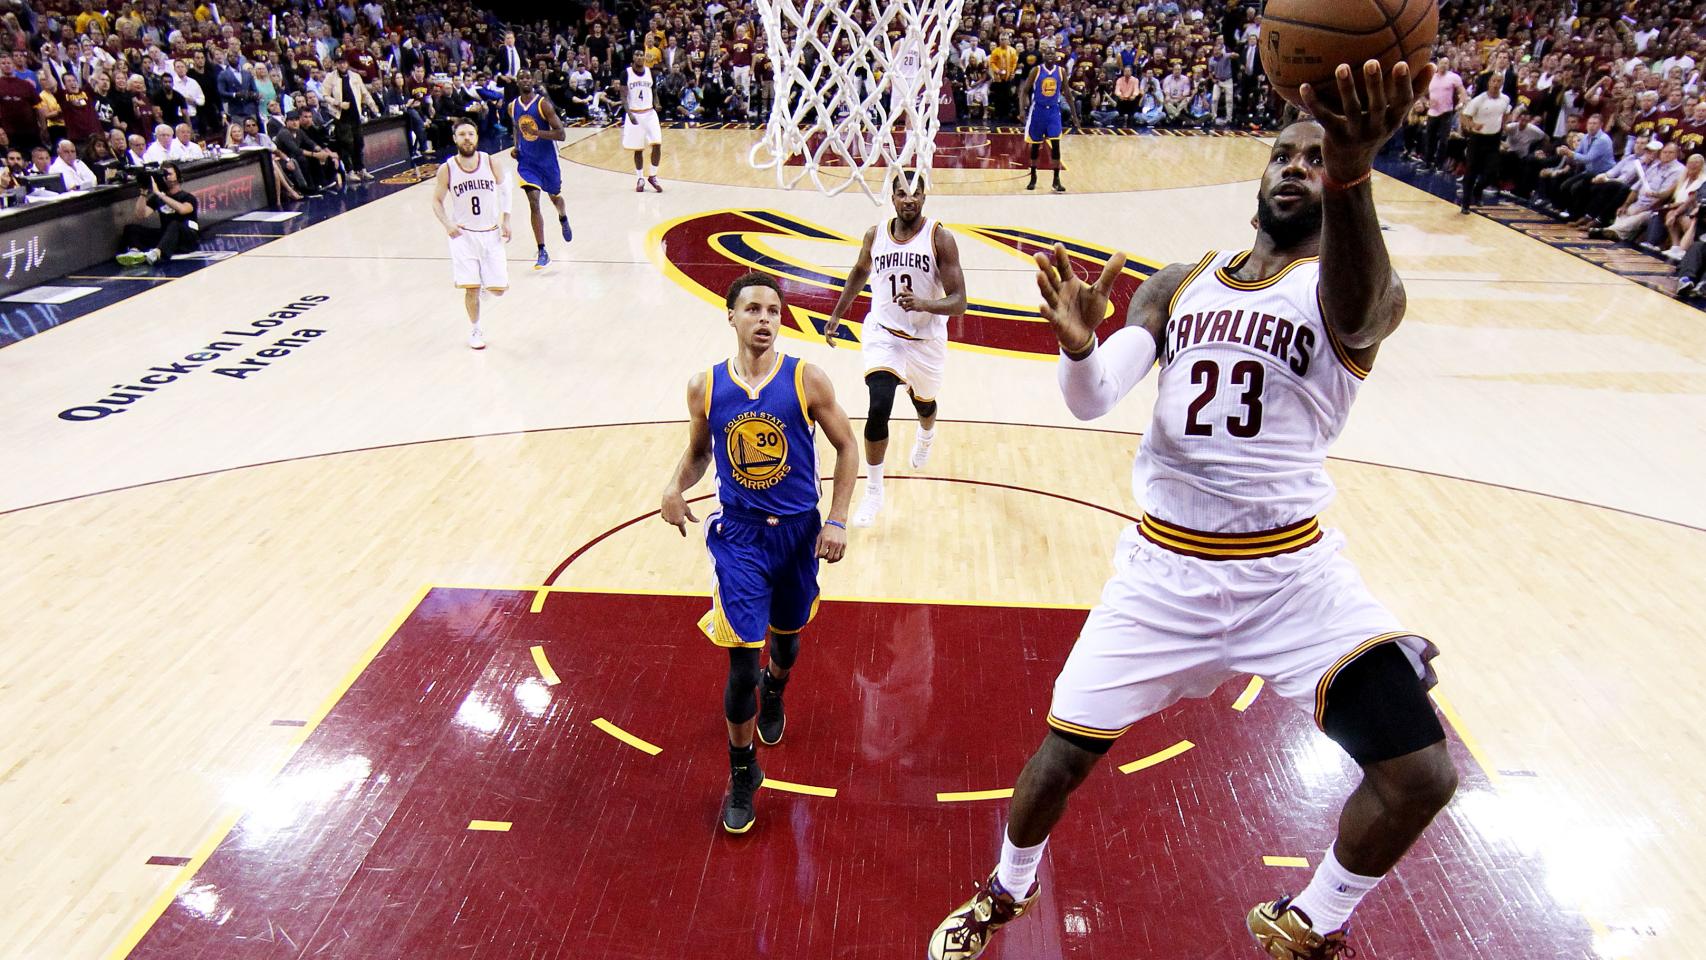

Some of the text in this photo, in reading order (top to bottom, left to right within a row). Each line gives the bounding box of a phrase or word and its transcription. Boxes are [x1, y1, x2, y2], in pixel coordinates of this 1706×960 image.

[904, 57, 914, 66] 20
[638, 90, 644, 101] 4
[453, 179, 495, 197] CAVALIERS
[471, 196, 481, 216] 8
[874, 252, 930, 274] CAVALIERS
[211, 326, 328, 380] Arena
[1166, 310, 1316, 378] CAVALIERS
[57, 293, 331, 422] Quicken Loans
[1184, 360, 1265, 438] 23
[724, 411, 788, 434] GOLDEN STATE
[755, 431, 778, 448] 30
[731, 464, 792, 491] WARRIORS
